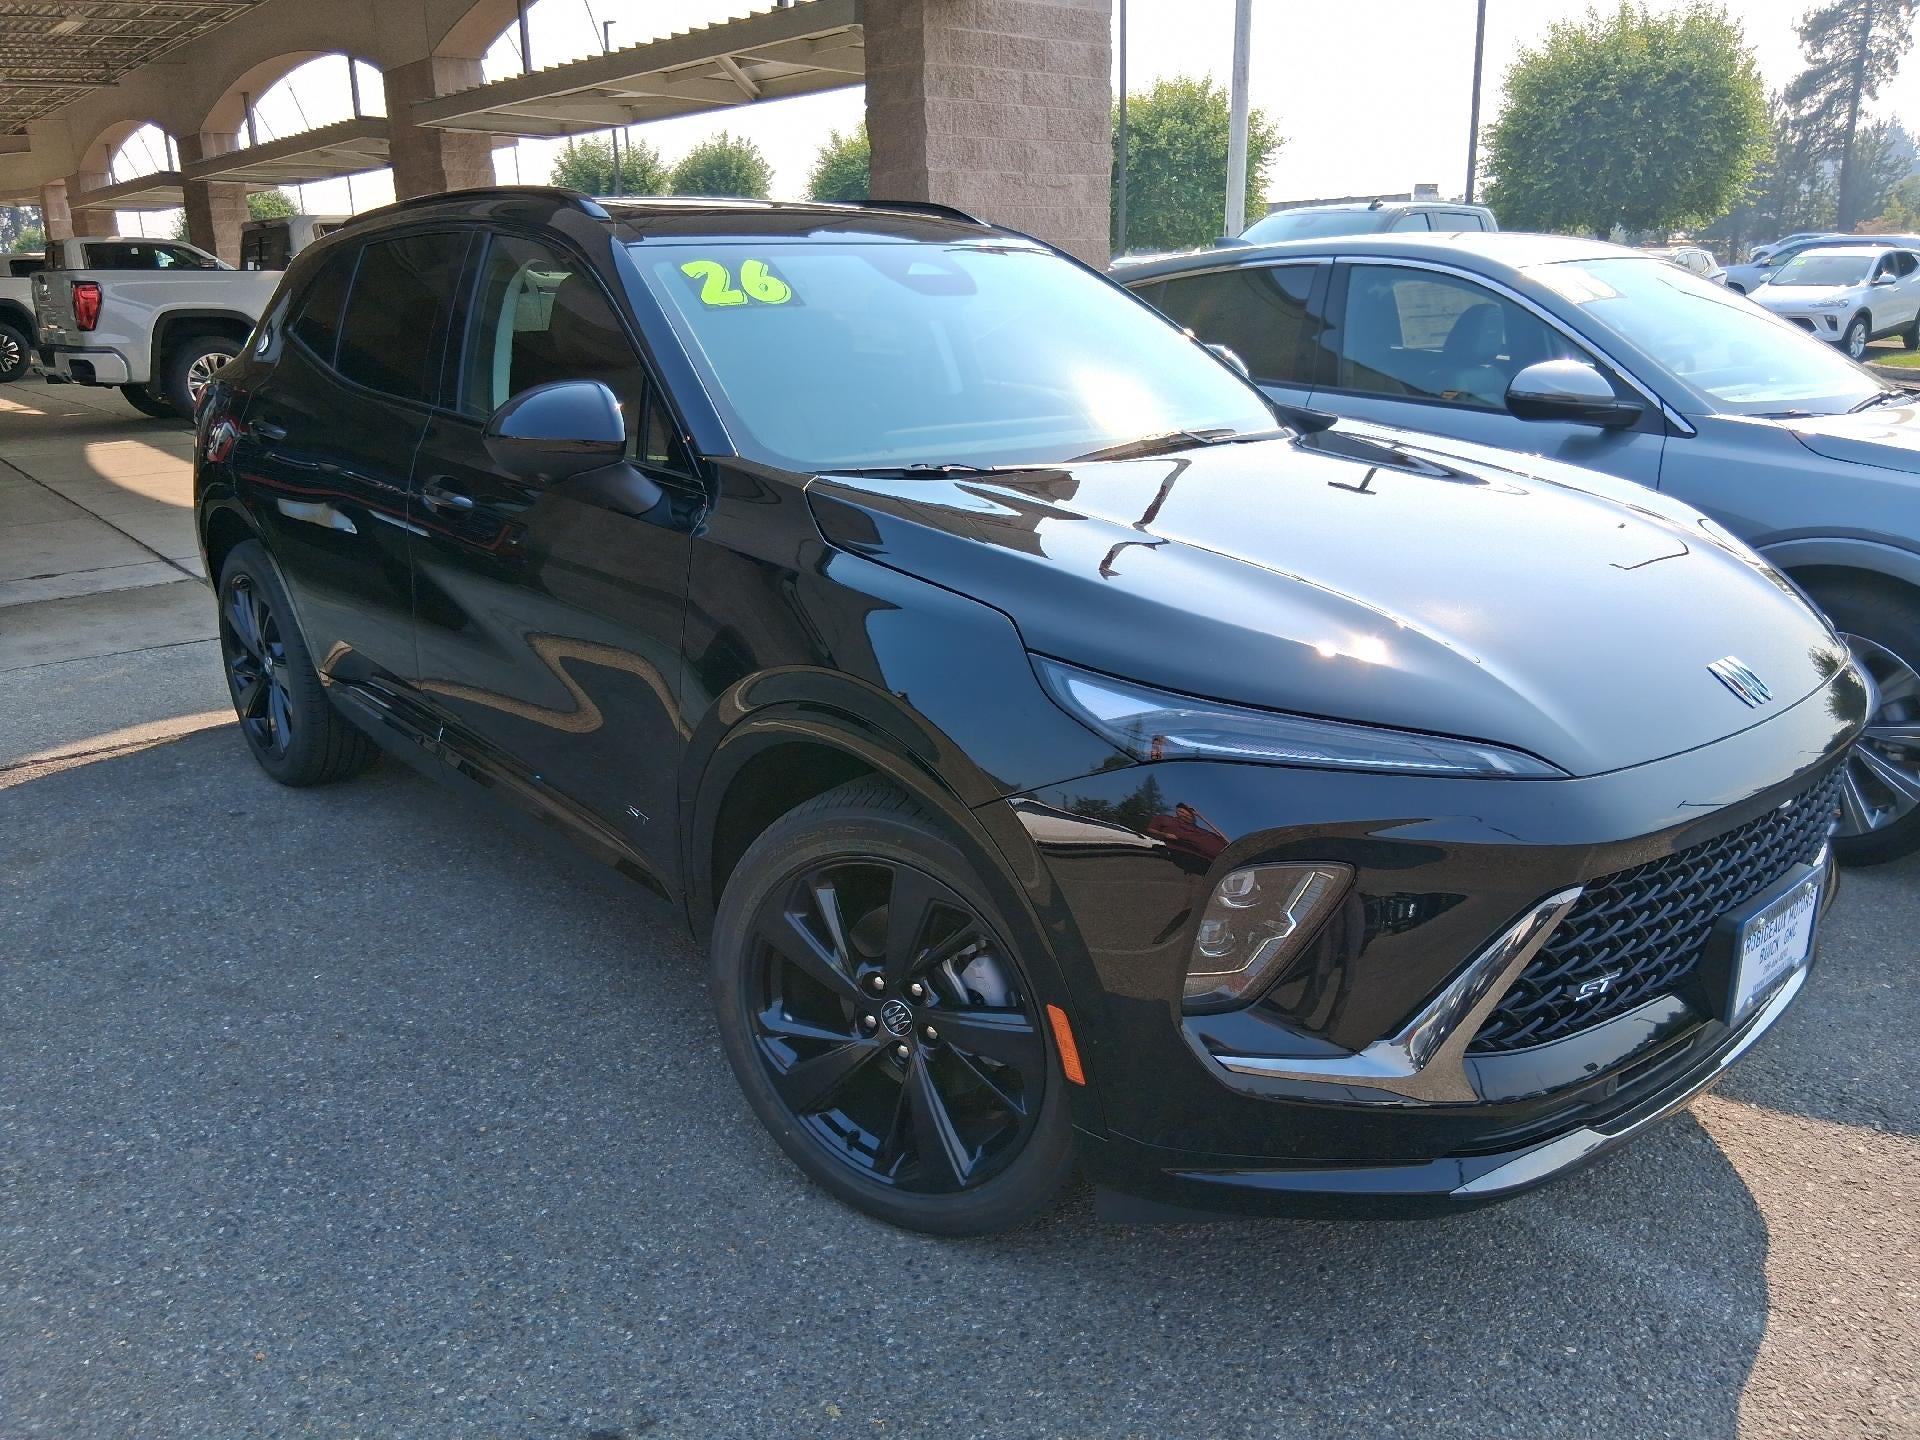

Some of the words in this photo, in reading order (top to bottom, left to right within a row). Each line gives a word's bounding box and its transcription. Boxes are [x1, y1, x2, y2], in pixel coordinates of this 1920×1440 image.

[680, 259, 792, 306] 26
[1789, 887, 1816, 920] MOTORS
[1760, 937, 1779, 965] BUICK
[1784, 921, 1797, 945] GMC
[1575, 968, 1622, 1002] ST
